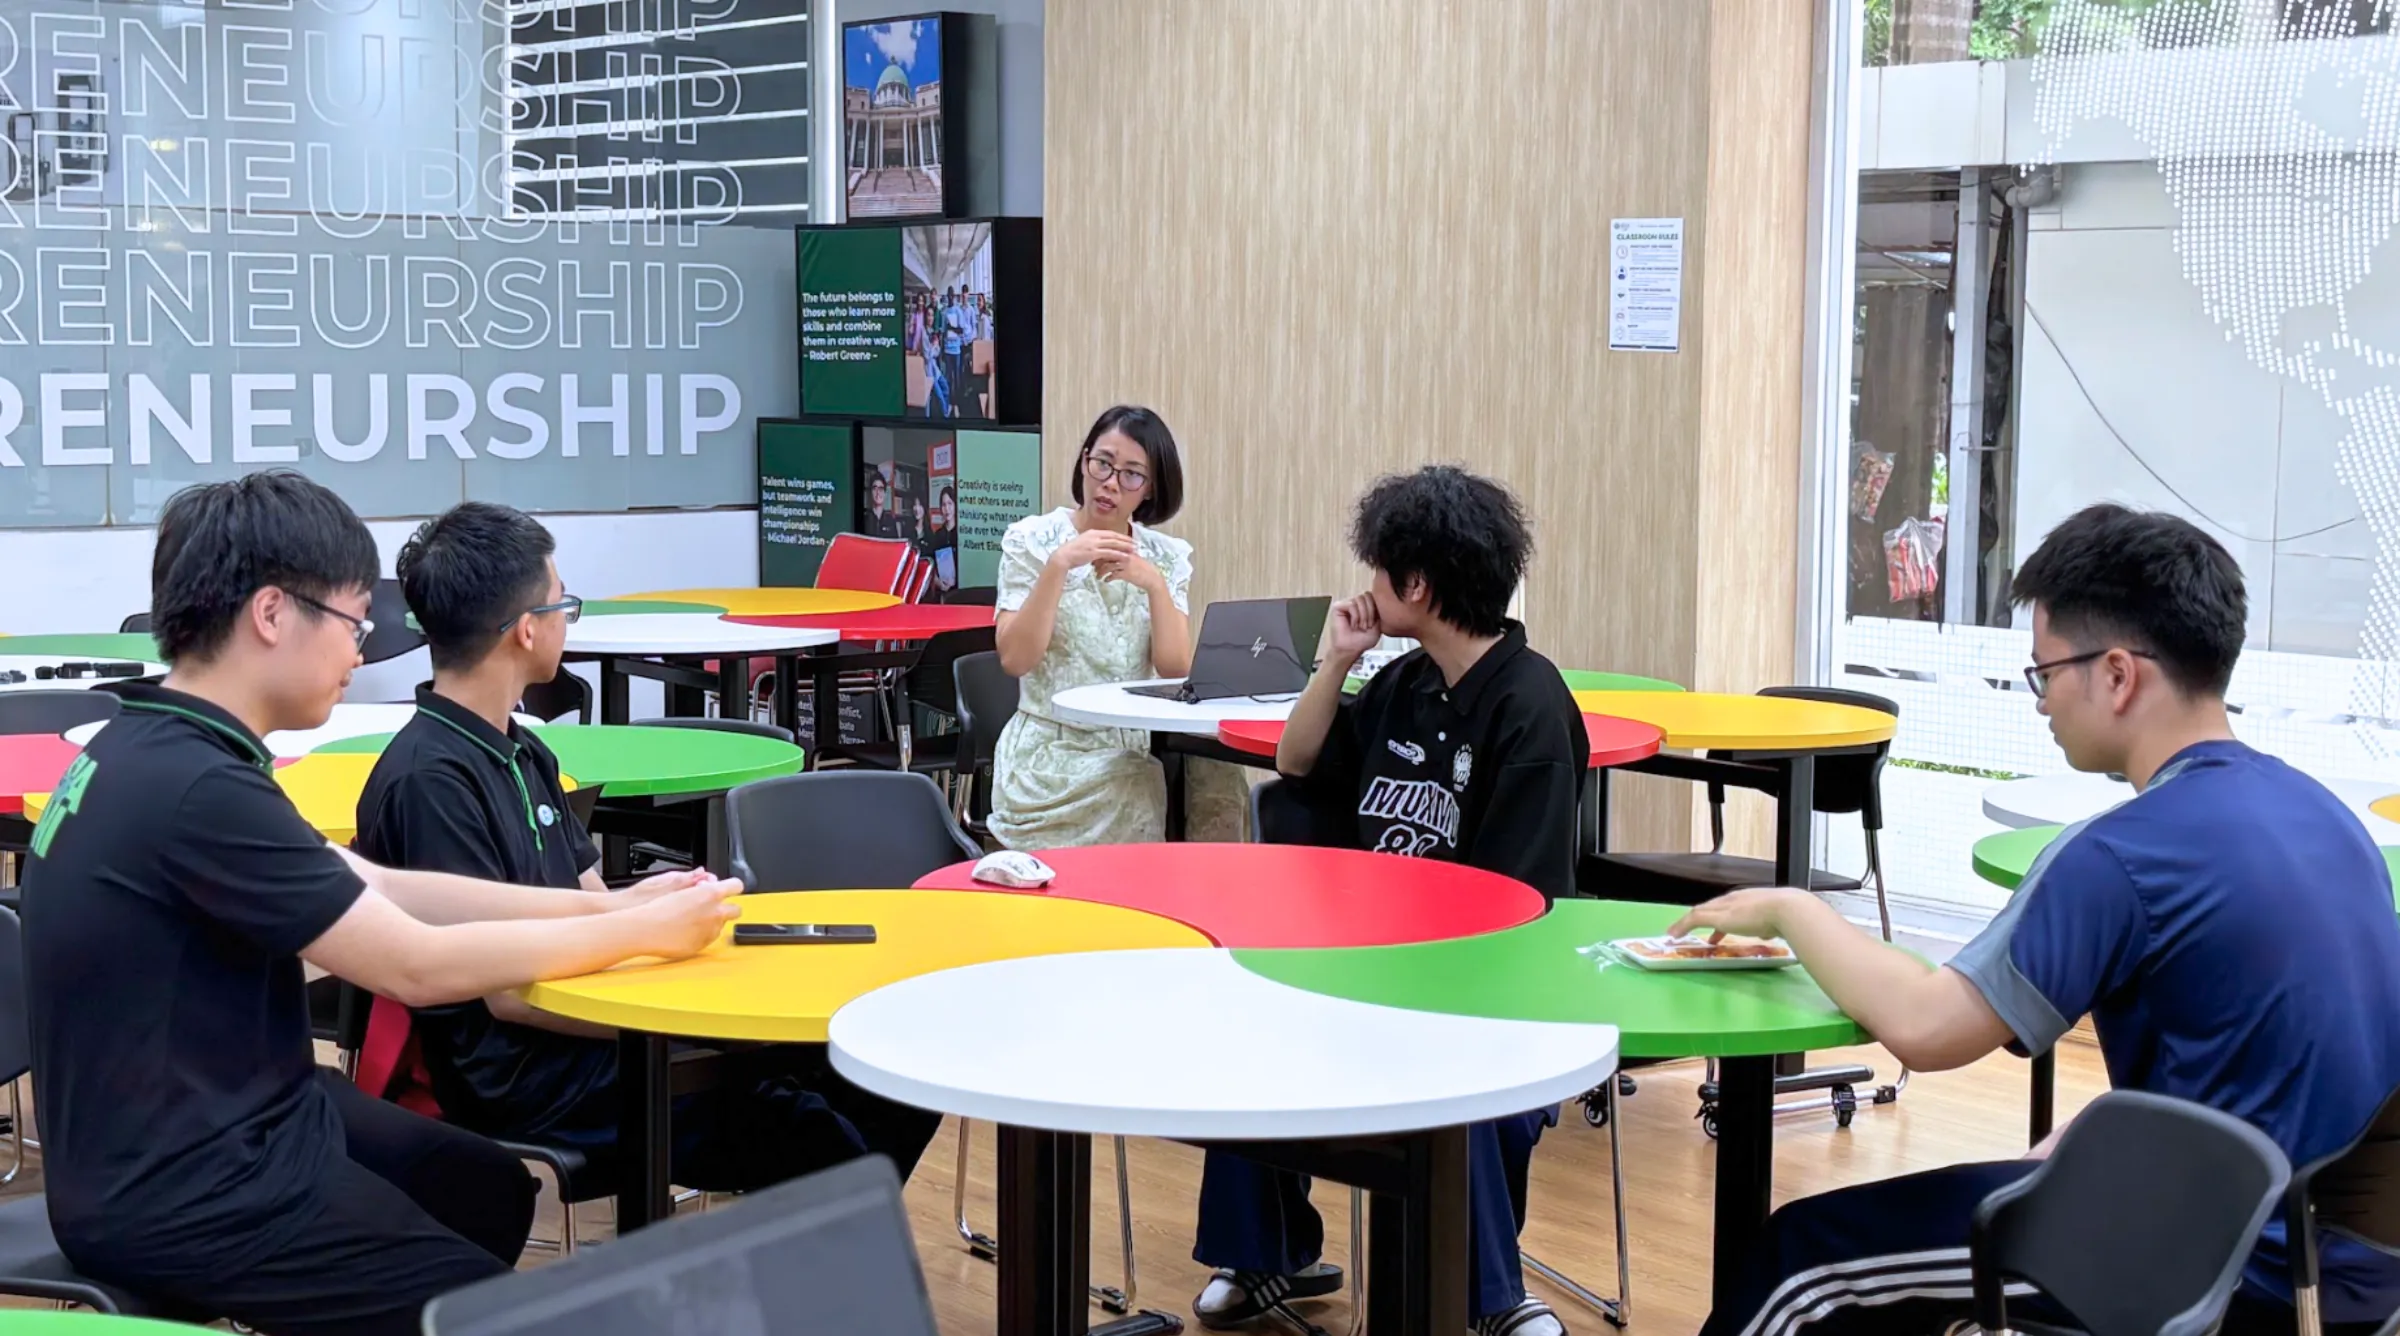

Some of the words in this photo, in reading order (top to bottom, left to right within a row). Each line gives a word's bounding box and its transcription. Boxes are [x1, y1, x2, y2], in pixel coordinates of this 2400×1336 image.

[802, 293, 819, 303] The
[820, 291, 847, 303] future
[848, 291, 883, 304] belongs
[884, 291, 894, 302] to
[802, 307, 826, 317] those
[828, 307, 847, 317] who
[848, 306, 871, 317] learn
[872, 308, 896, 317] more
[802, 320, 824, 332] skills
[826, 321, 842, 331] and
[844, 320, 882, 331] combine
[803, 336, 826, 346] them
[827, 335, 836, 346] in
[837, 335, 872, 346] creative
[873, 337, 898, 348] ways.
[809, 349, 839, 360] Robert
[840, 350, 871, 360] Greene
[762, 476, 786, 487] Talent
[787, 477, 805, 488] wins
[806, 480, 835, 491] games,
[959, 479, 991, 493] Creativity
[992, 480, 999, 491] is
[999, 481, 1024, 494] seeing
[762, 490, 776, 500] but
[777, 492, 815, 502] teamwork
[817, 494, 832, 504] and
[959, 496, 977, 505] what
[978, 496, 1000, 506] others
[1015, 498, 1029, 508] and
[763, 503, 806, 517] intelligence
[808, 506, 822, 517] win
[959, 509, 988, 523] thinking
[989, 512, 1008, 522] what
[763, 519, 820, 533] championships
[767, 532, 797, 544] Michael
[798, 534, 825, 546] Jordan
[963, 540, 985, 551] Albert
